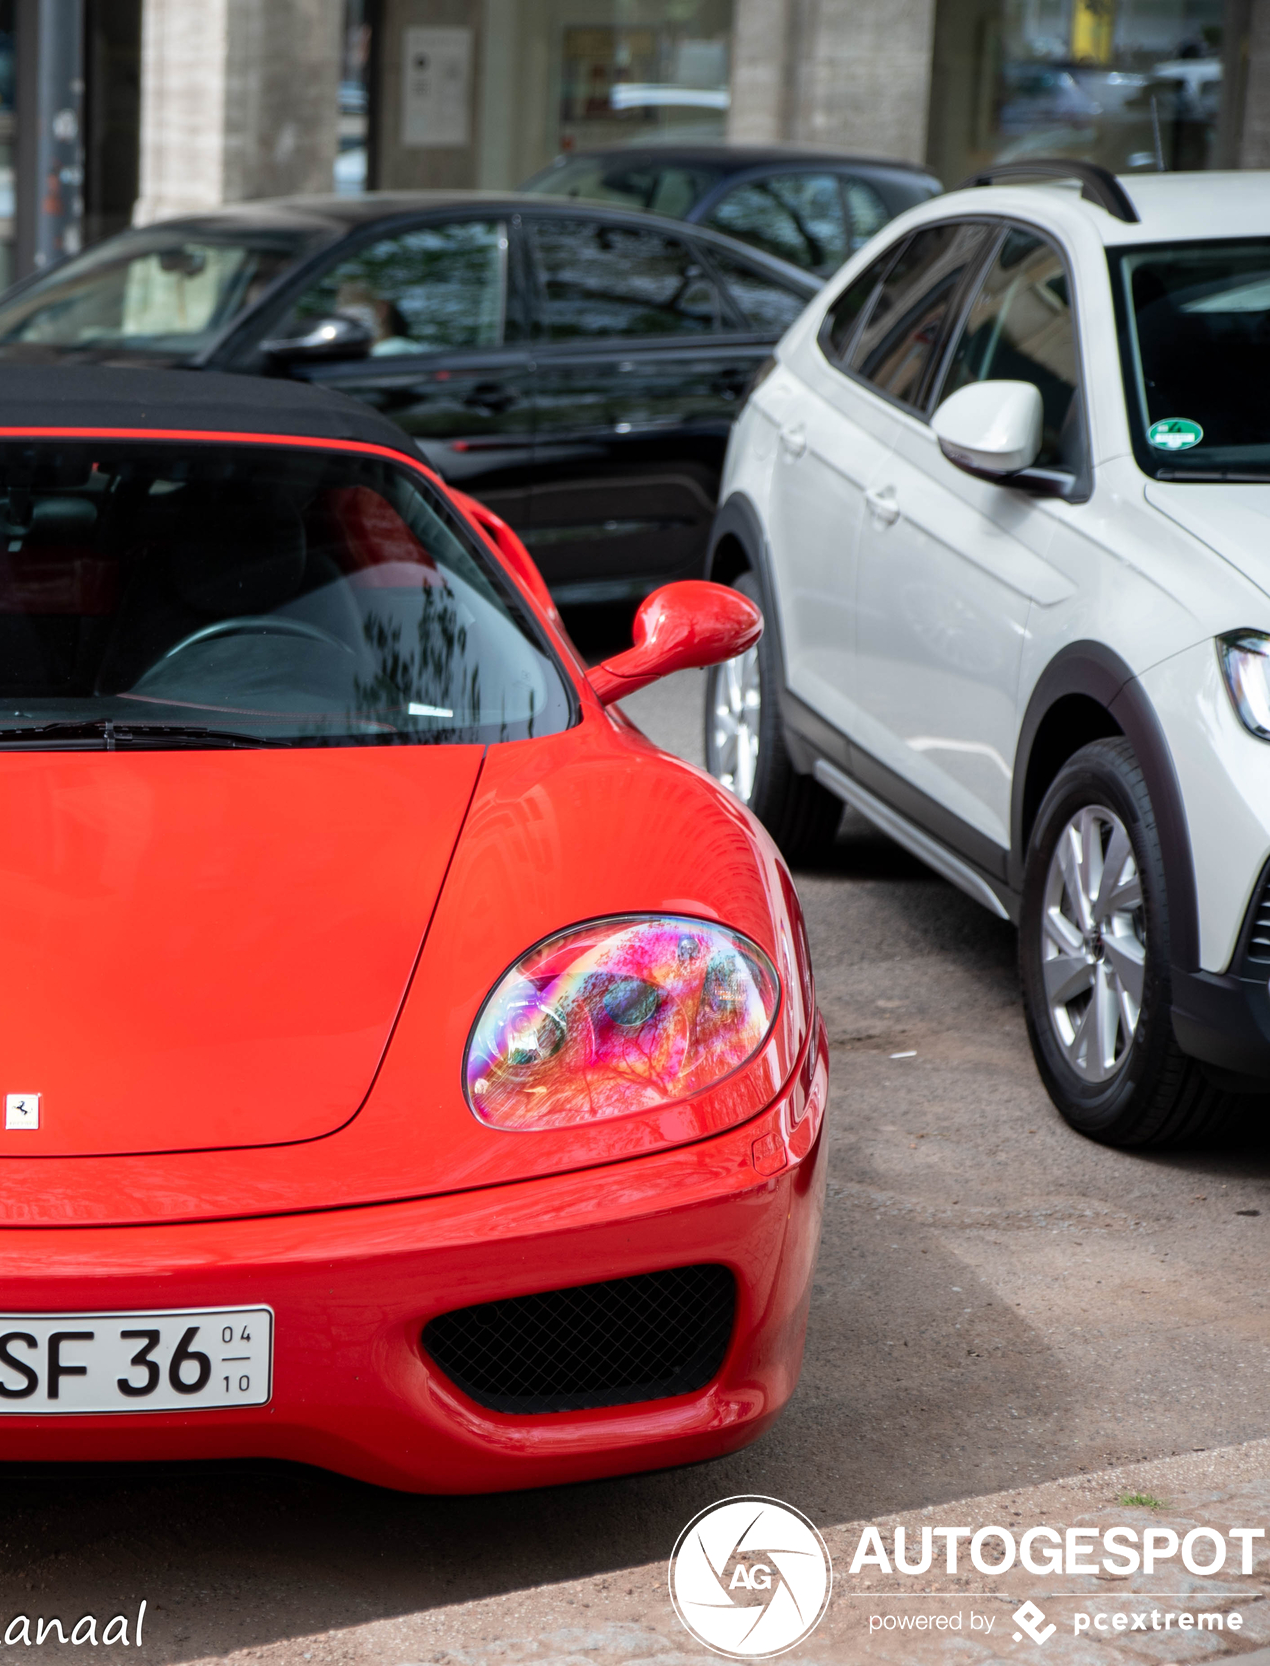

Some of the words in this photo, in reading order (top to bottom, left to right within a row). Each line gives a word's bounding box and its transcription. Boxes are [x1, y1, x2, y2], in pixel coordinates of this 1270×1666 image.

[221, 1325, 251, 1343] 04
[116, 1326, 212, 1398] 36
[223, 1374, 250, 1393] 10
